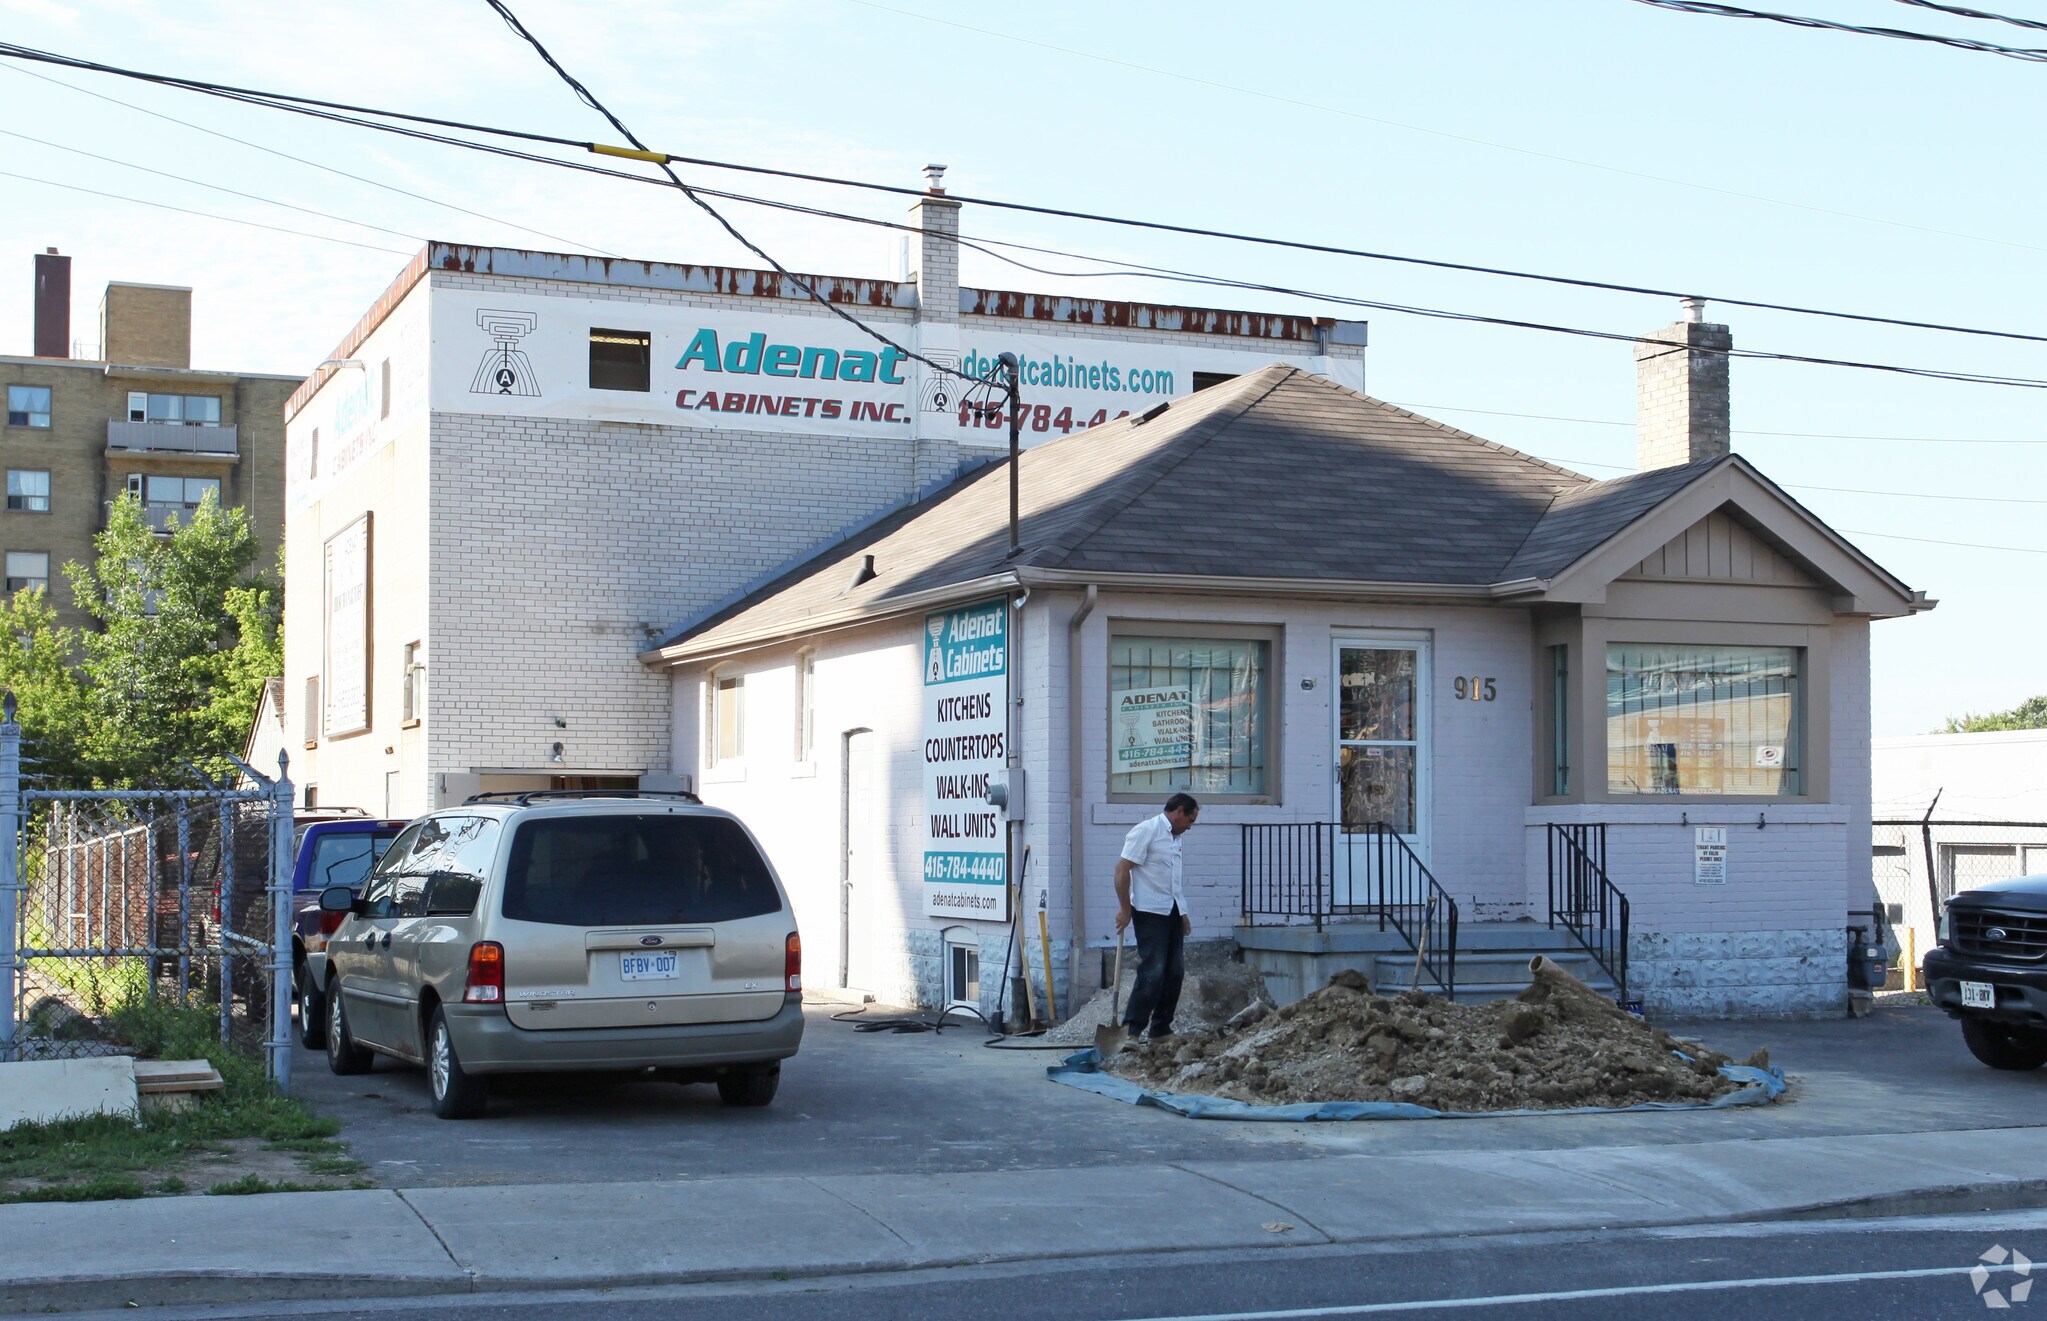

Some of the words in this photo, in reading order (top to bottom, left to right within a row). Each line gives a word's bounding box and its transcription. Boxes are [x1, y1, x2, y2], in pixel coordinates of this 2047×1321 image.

[675, 328, 909, 385] Adenat
[959, 348, 1174, 395] dentcabinets.com
[675, 389, 842, 419] CABINETS
[849, 401, 912, 424] INC.
[948, 607, 1003, 644] Adenat
[946, 644, 1004, 678] Cabinets
[1121, 690, 1188, 706] ADENAT
[1454, 676, 1496, 701] 915
[937, 692, 991, 723] KITCHENS
[1156, 709, 1190, 718] KITCHENS
[925, 732, 1004, 763] COUNTERTOPS
[1122, 745, 1194, 759] 416-784-444
[937, 773, 989, 799] WALK-INS
[930, 813, 960, 838] WALL
[964, 813, 997, 839] UNITS
[925, 855, 1003, 881] 416-784-4440
[932, 892, 997, 910] adenatcabinets.com
[519, 989, 576, 998] WINDSTAR
